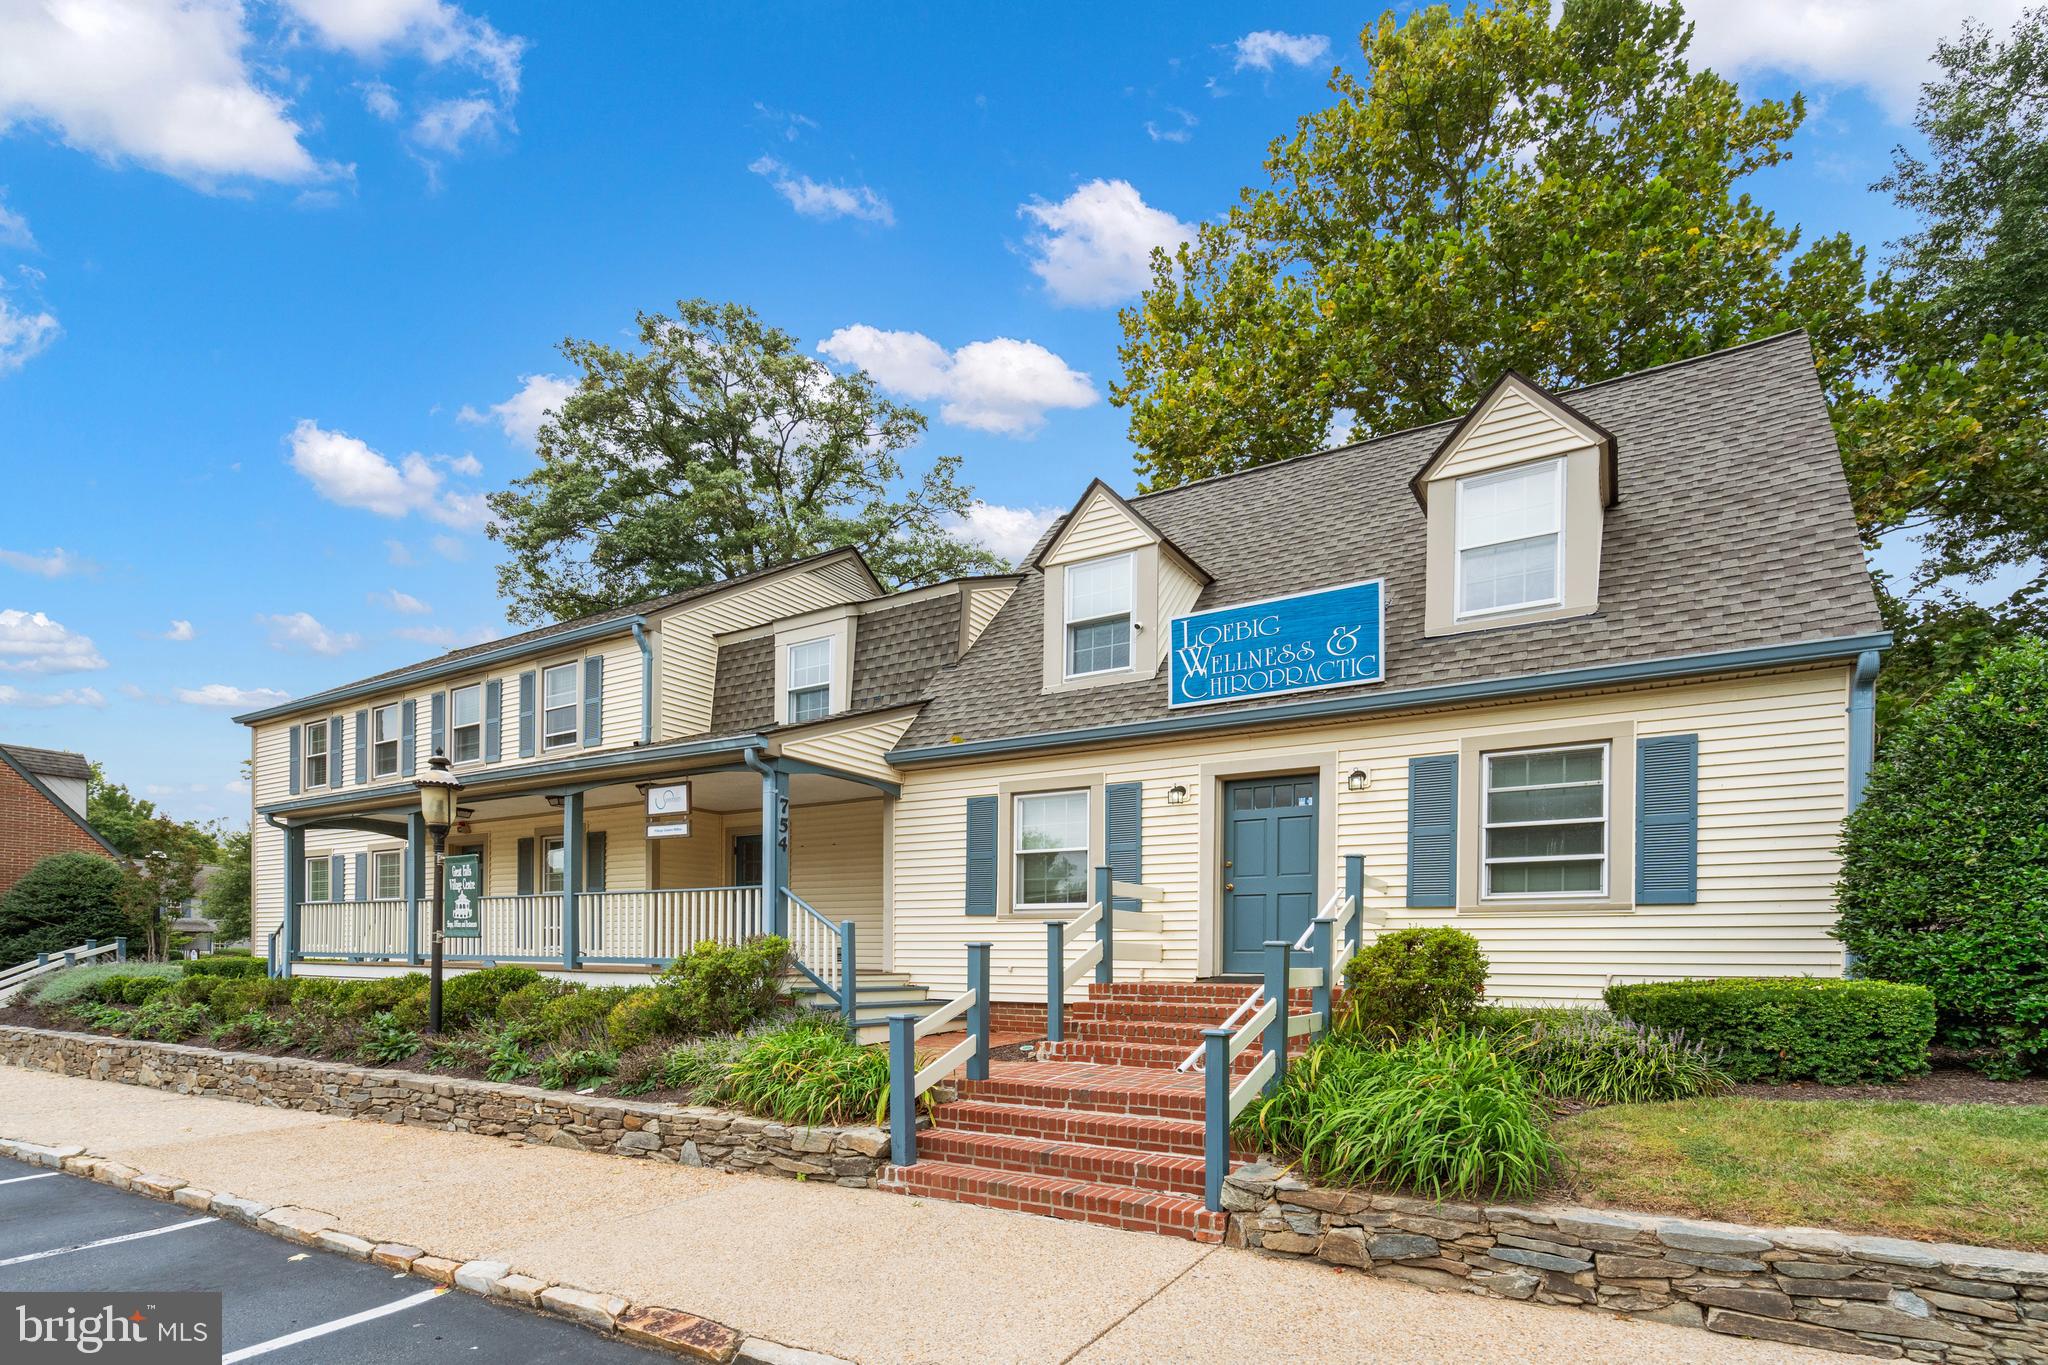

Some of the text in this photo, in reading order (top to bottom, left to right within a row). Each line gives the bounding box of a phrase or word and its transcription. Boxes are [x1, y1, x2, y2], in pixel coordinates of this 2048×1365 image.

[1176, 625, 1362, 679] WELLNESS &
[1181, 615, 1281, 651] LOEBIG
[1181, 654, 1376, 700] CHIROPRACTIC
[778, 797, 789, 852] 754
[449, 878, 462, 893] Village
